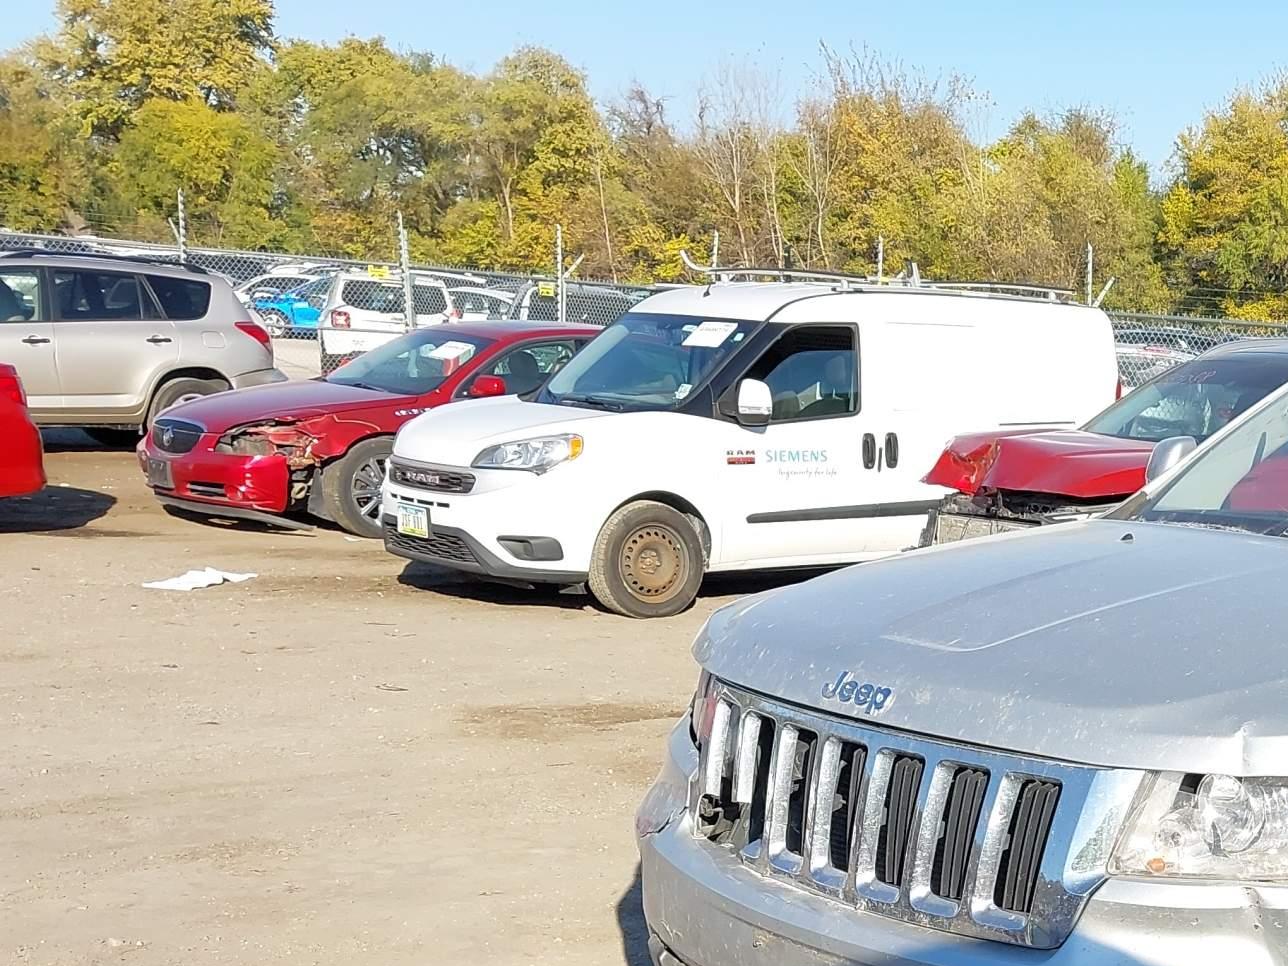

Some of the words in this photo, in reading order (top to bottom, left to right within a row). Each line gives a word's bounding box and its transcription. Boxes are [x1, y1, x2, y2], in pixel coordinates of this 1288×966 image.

[765, 449, 828, 463] SIEMENS
[406, 471, 440, 484] RAM
[821, 670, 895, 715] Jeep
